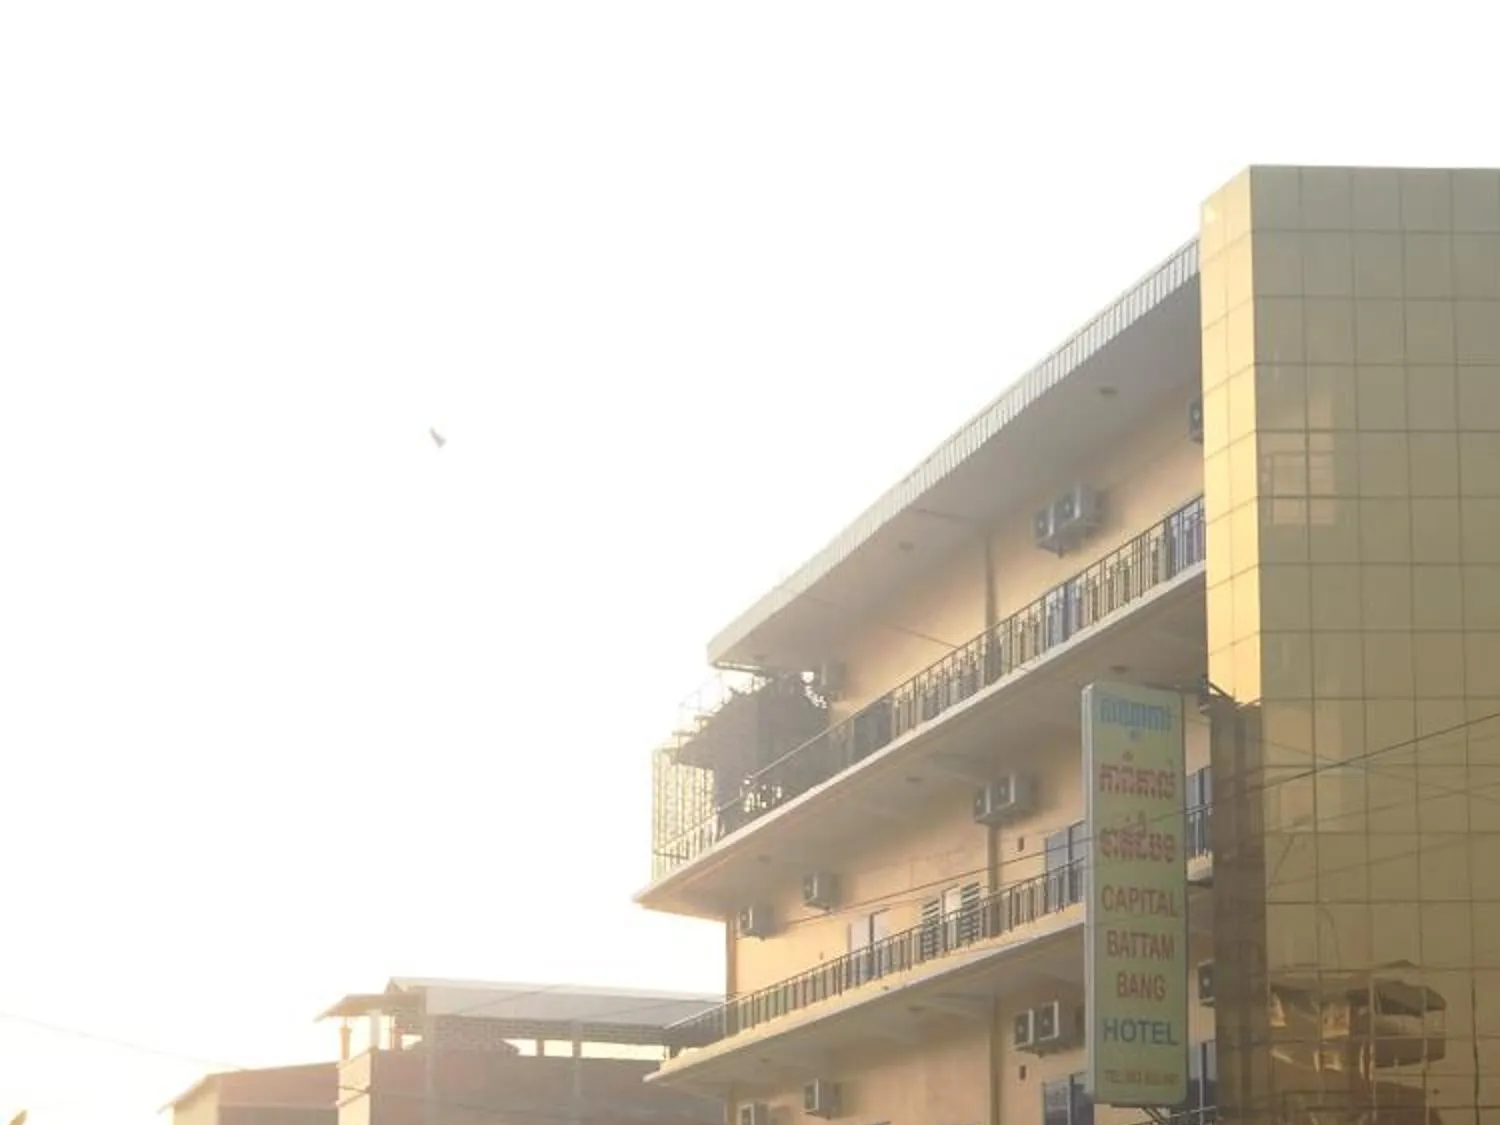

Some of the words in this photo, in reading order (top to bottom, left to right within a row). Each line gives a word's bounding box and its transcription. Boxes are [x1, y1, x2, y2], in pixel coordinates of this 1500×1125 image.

[1102, 884, 1179, 918] CAPITAL
[1107, 929, 1175, 962] BATTAM
[1117, 972, 1166, 1001] BANG
[1103, 1018, 1179, 1046] HOTEL
